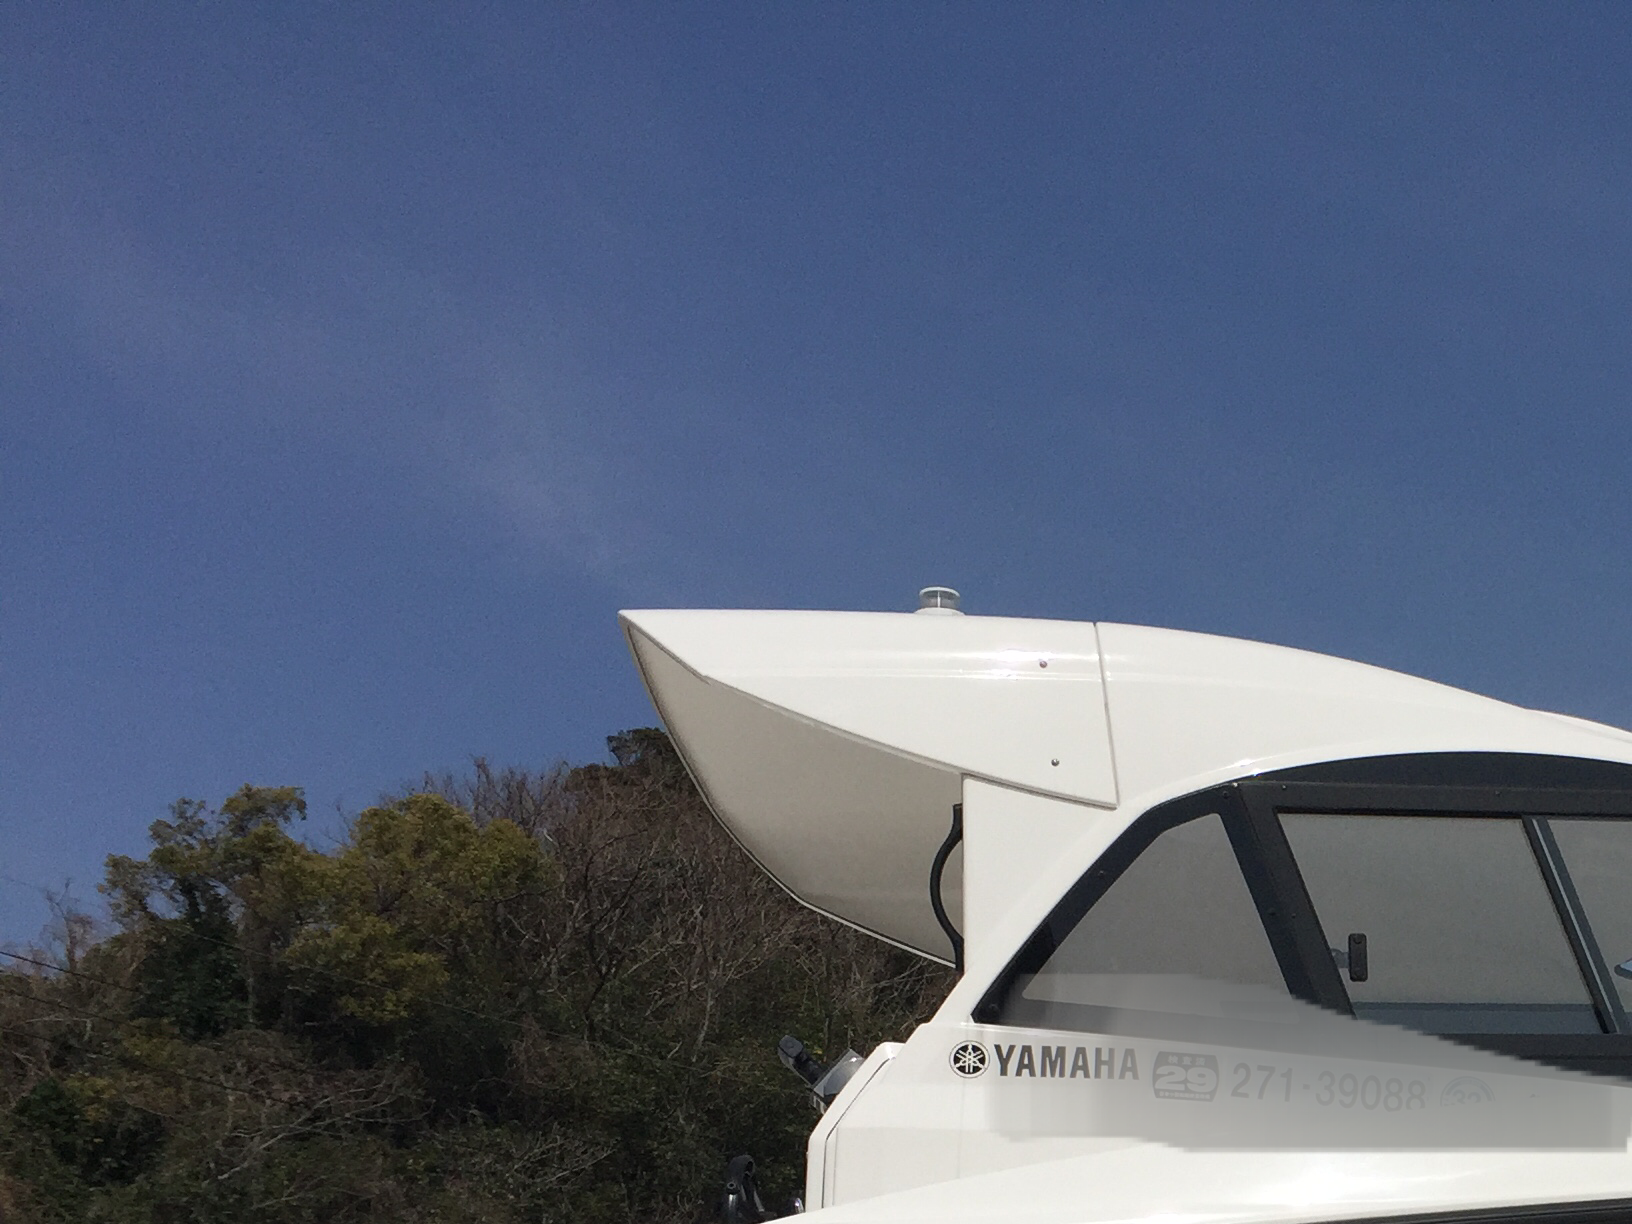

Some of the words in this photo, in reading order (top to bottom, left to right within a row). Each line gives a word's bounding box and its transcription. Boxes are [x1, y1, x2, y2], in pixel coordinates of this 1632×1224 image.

[994, 1043, 1139, 1080] YAMAHA
[1154, 1065, 1217, 1093] 29
[1230, 1061, 1427, 1112] 271-39088
